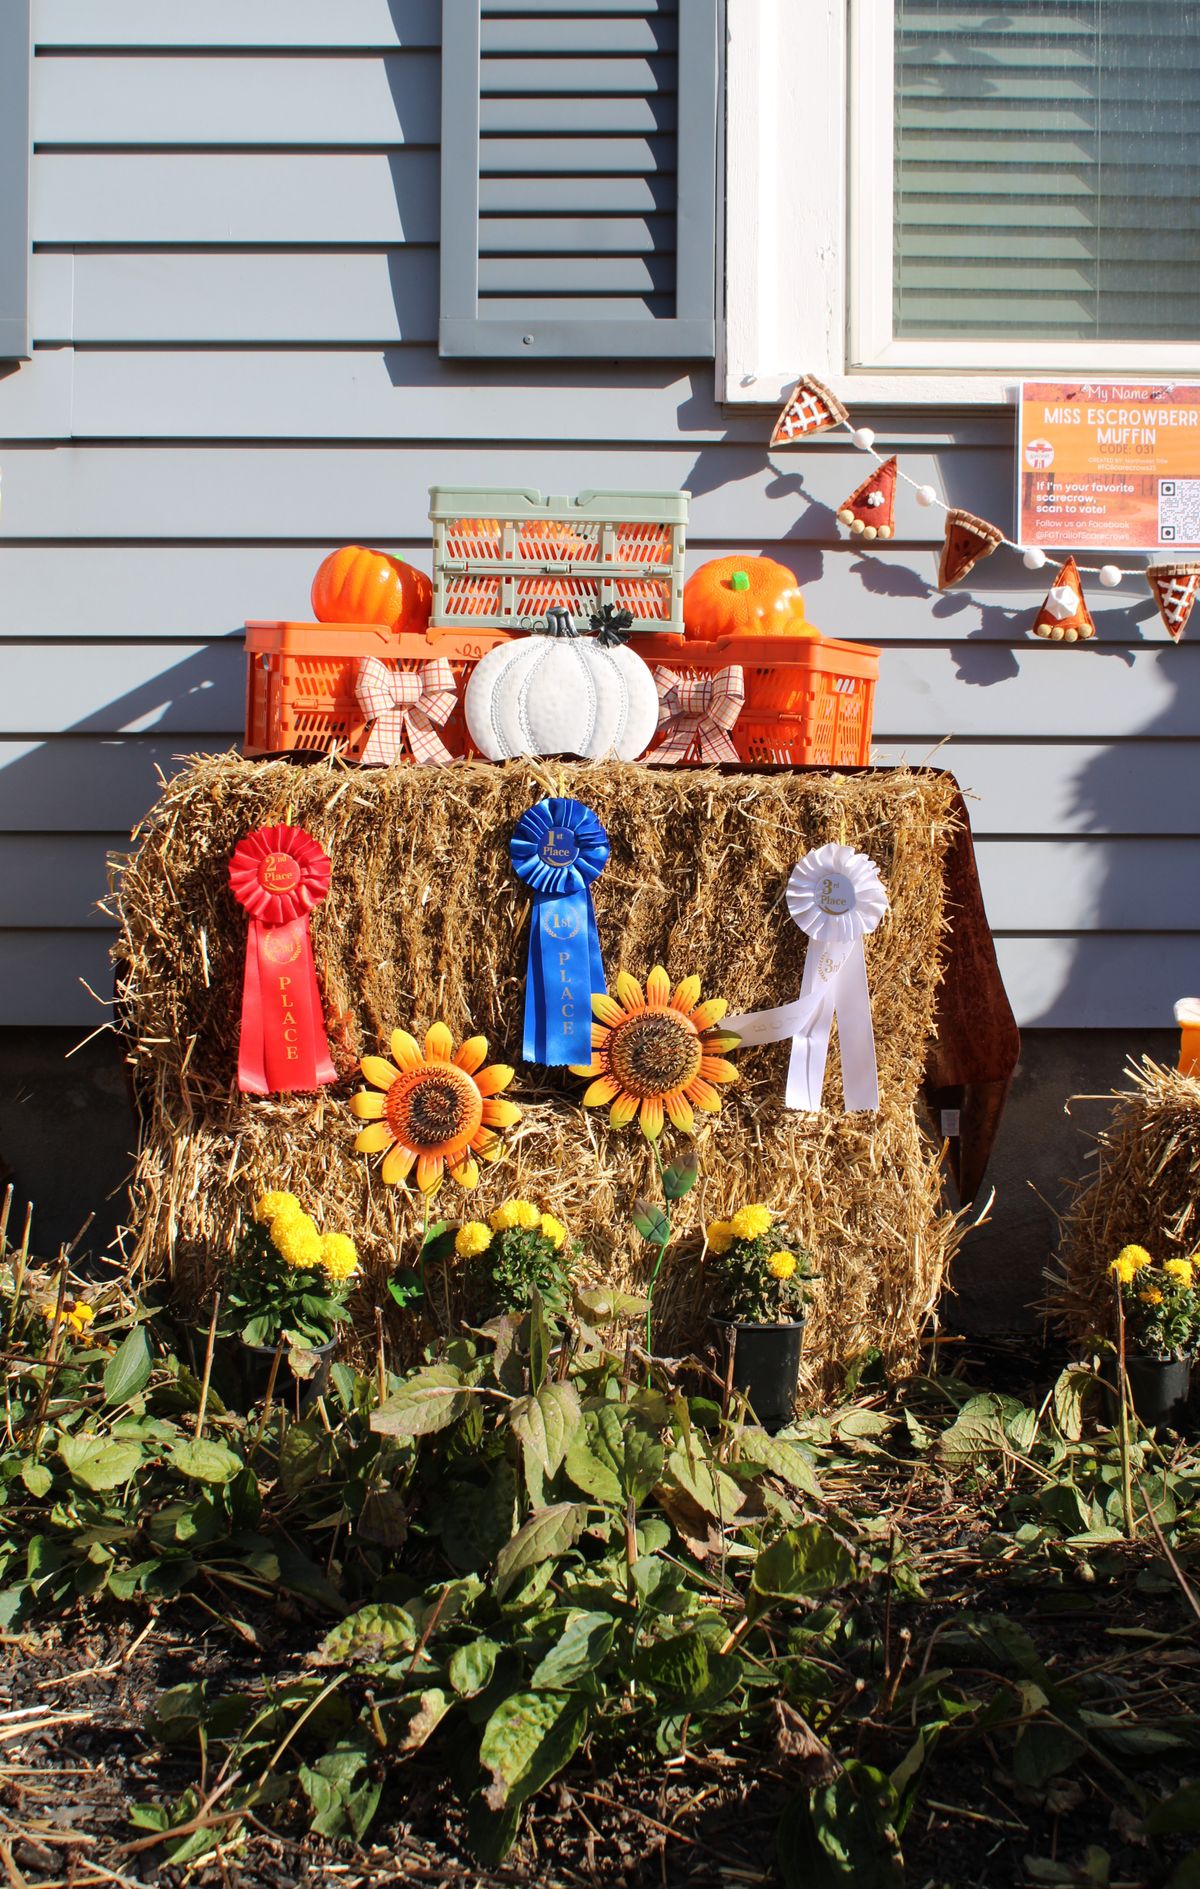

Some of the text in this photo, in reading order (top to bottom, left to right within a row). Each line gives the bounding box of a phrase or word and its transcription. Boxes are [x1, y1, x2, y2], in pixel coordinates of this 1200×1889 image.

[1088, 385, 1108, 402] My
[1112, 386, 1148, 400] Name
[1044, 408, 1200, 426] MISS ESCROWBERR
[1096, 428, 1156, 445] MUFFIN
[1099, 444, 1154, 455] CODE: 031
[1036, 481, 1135, 493] If I'm your favorite
[1036, 495, 1097, 504] scarecrow,
[1065, 505, 1077, 513] to
[1079, 505, 1106, 514] vote!
[1035, 519, 1062, 527] Follow
[1088, 520, 1130, 529] Facebook
[547, 830, 563, 846] 1st
[542, 846, 570, 857] Place
[265, 855, 287, 871] 2nd
[264, 871, 293, 882] Place
[822, 879, 840, 895] 3rd
[820, 894, 847, 907] Place
[553, 913, 572, 929] 1st
[558, 952, 575, 1035] PLACE
[279, 977, 299, 1061] PLACE
